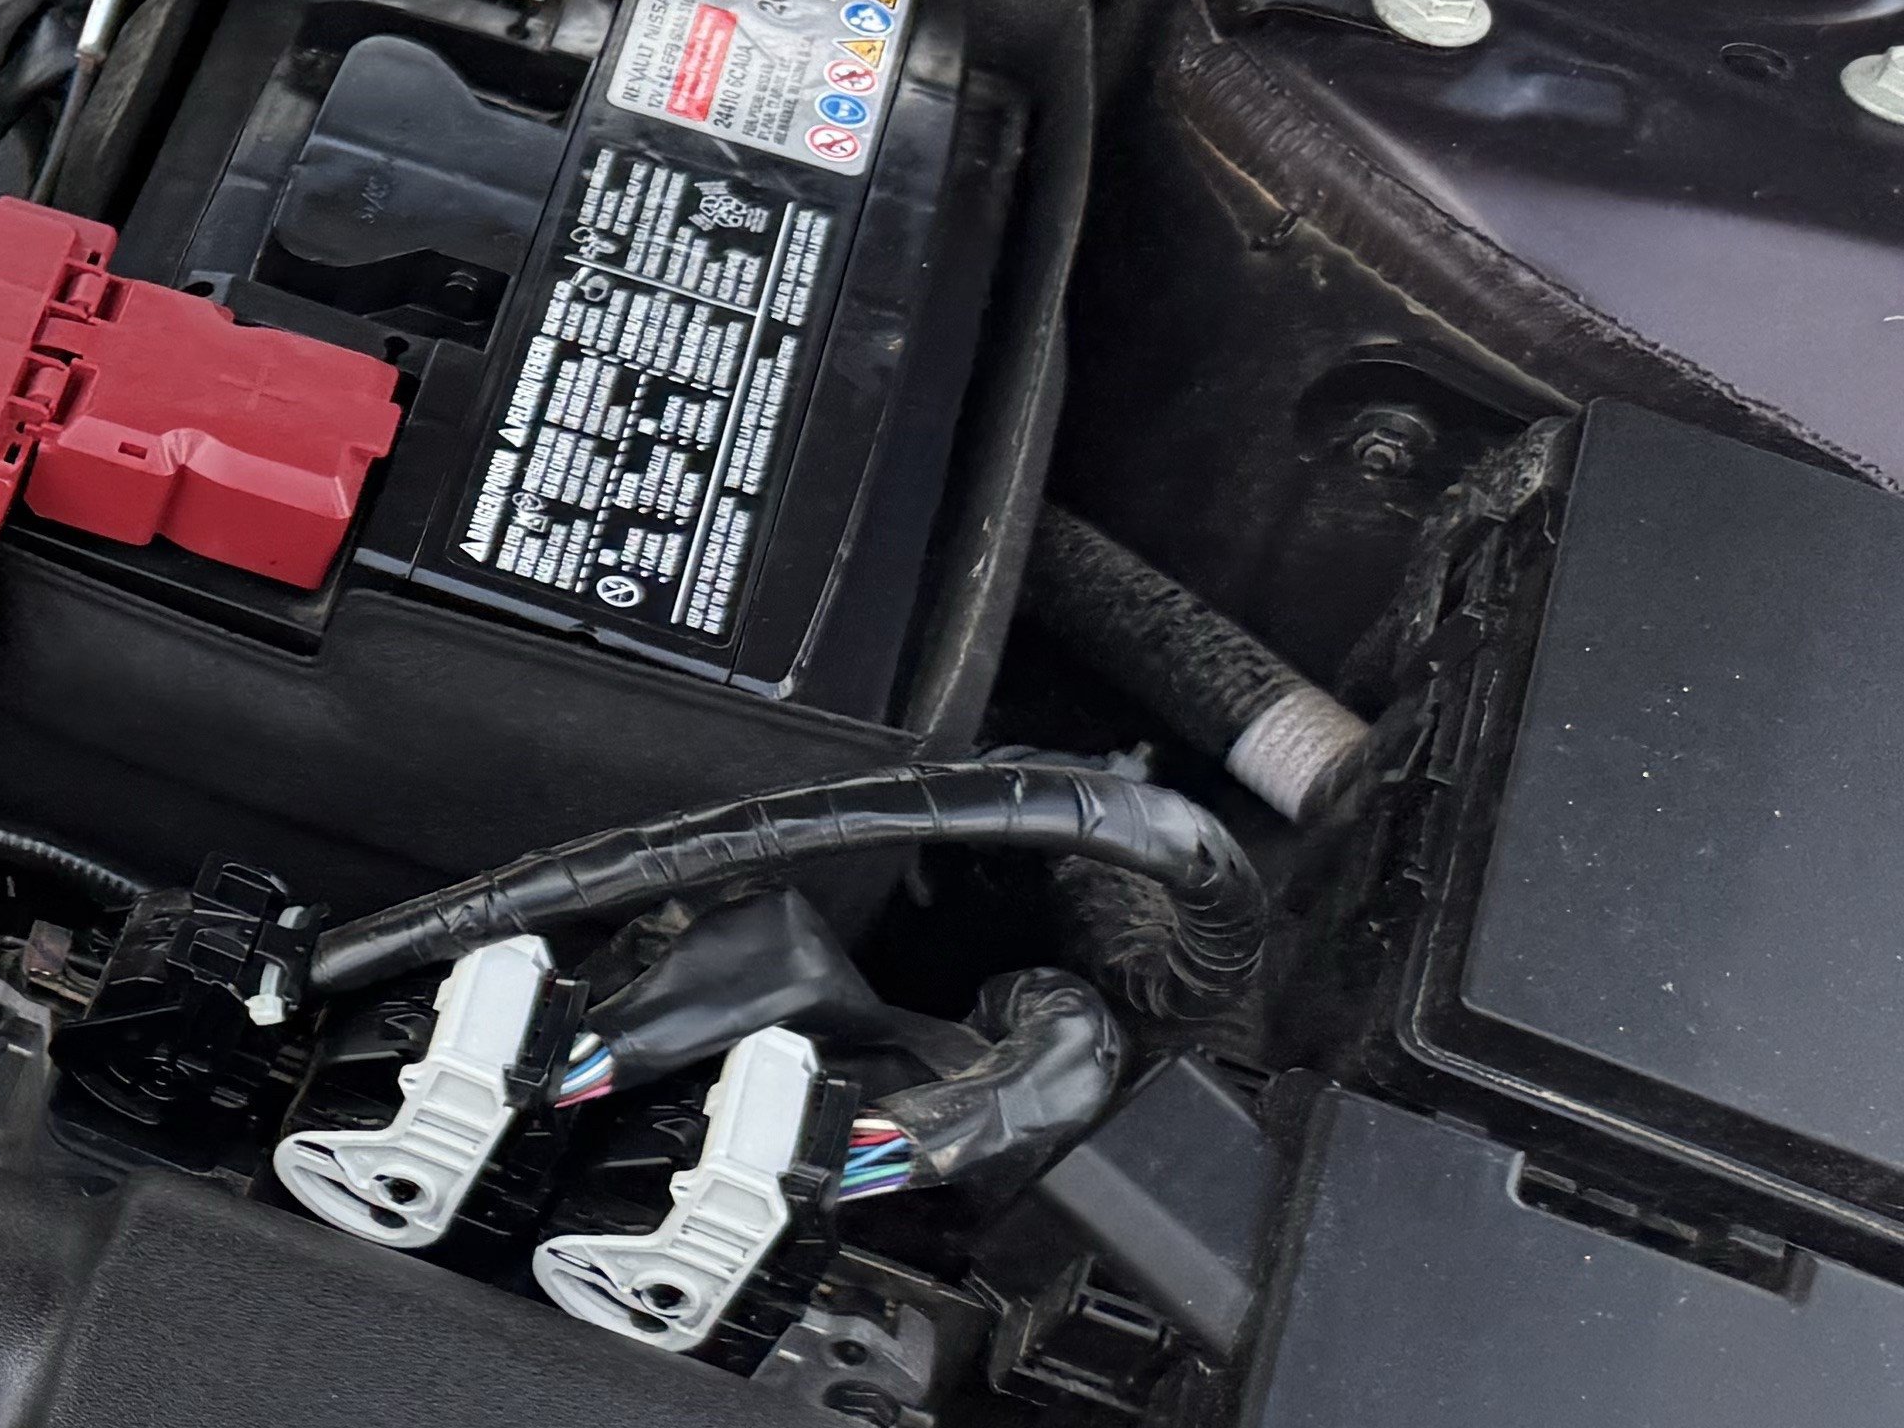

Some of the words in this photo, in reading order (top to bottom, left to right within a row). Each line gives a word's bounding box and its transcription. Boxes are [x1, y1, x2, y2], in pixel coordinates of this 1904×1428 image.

[621, 44, 654, 101] RENAULT
[712, 90, 740, 128] 24410
[506, 337, 558, 427] PELIGRO/VENENO
[467, 451, 519, 541] DANGER/POISON
